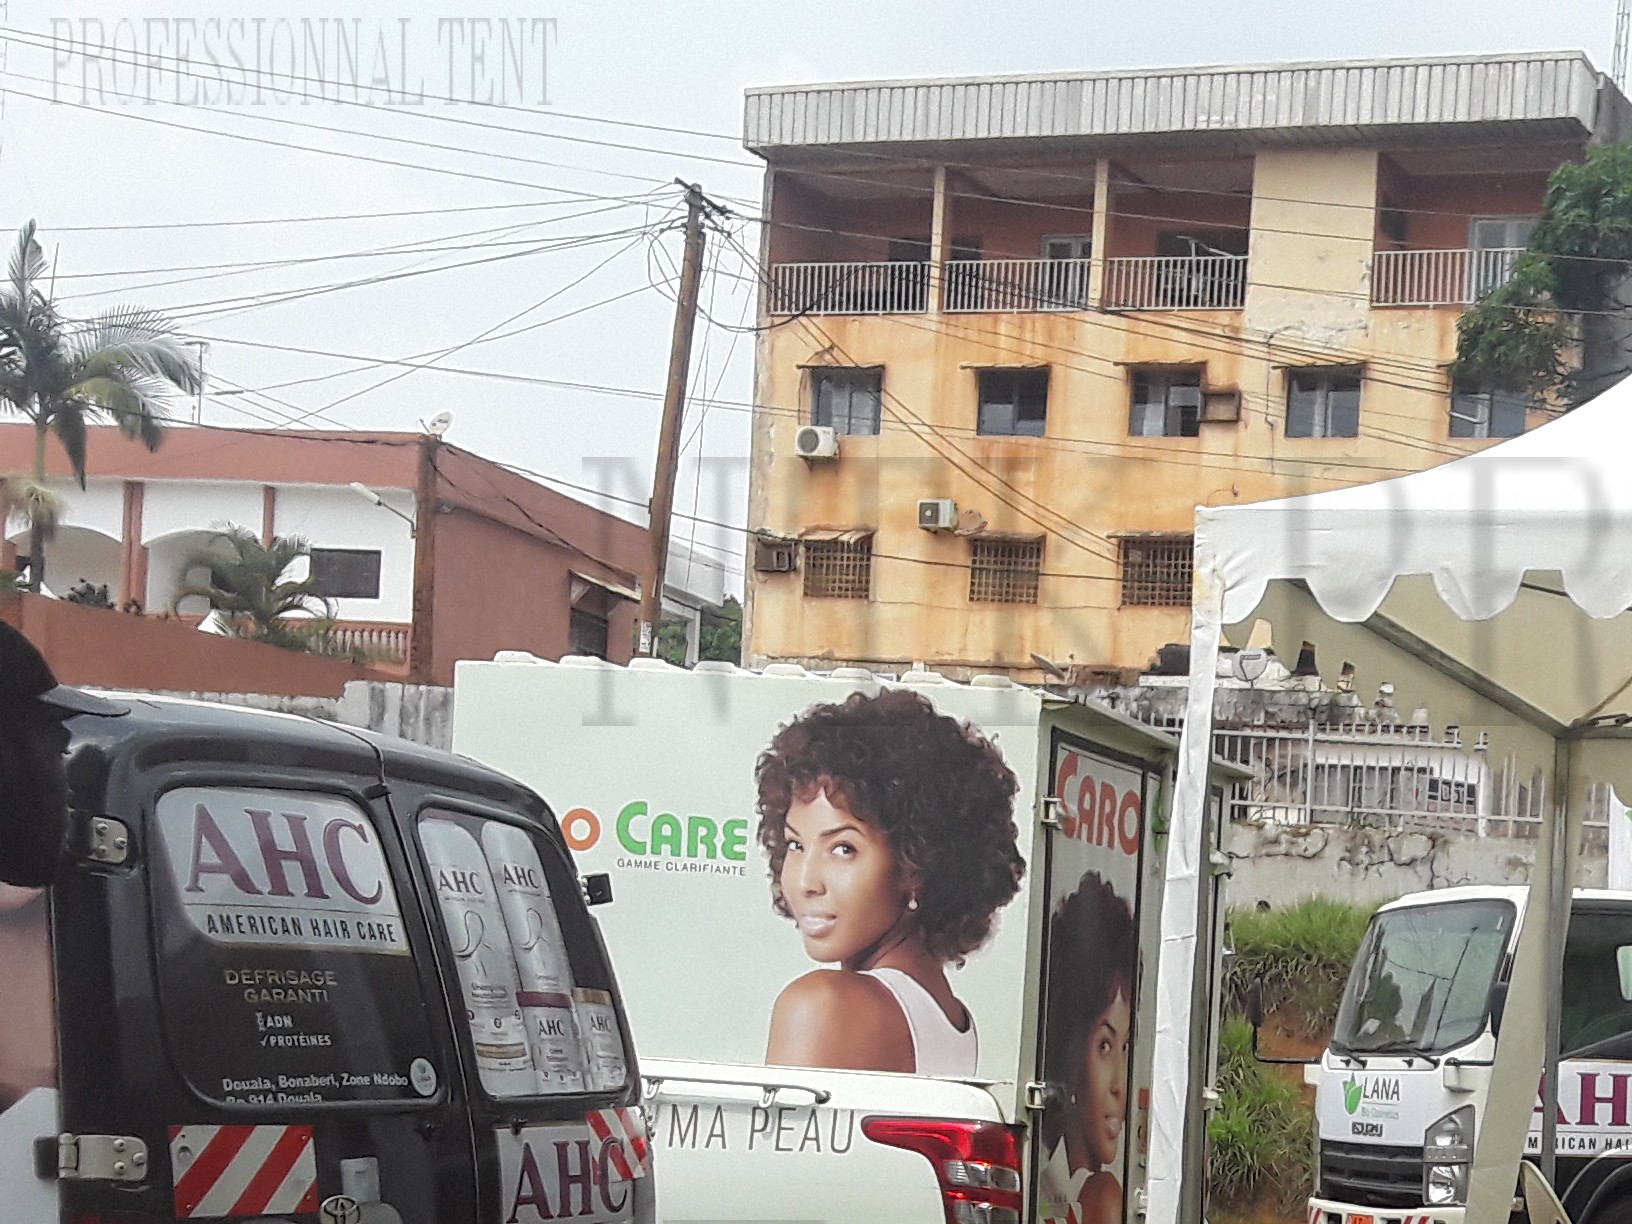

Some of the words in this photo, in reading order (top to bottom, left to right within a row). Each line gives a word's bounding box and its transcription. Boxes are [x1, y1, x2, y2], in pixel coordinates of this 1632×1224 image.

[1057, 752, 1140, 855] CARO
[616, 801, 748, 861] CARE
[185, 803, 382, 905] AHC
[504, 864, 539, 889] AHC
[617, 858, 660, 870] GAMME
[666, 861, 746, 876] CLARIFIANTE
[439, 869, 484, 895] AHC
[207, 914, 302, 937] AMERICAN
[310, 918, 350, 939] HAIR
[357, 921, 397, 943] CARE
[244, 988, 328, 1003] GARANTI
[267, 1014, 293, 1028] ADN
[539, 1019, 564, 1036] AHC
[590, 1014, 611, 1033] AHC
[341, 1072, 370, 1086] Zone
[1362, 1077, 1400, 1101] LANA
[668, 1104, 727, 1149] MA
[749, 1106, 854, 1153] PEAU
[506, 1136, 628, 1224] AHC
